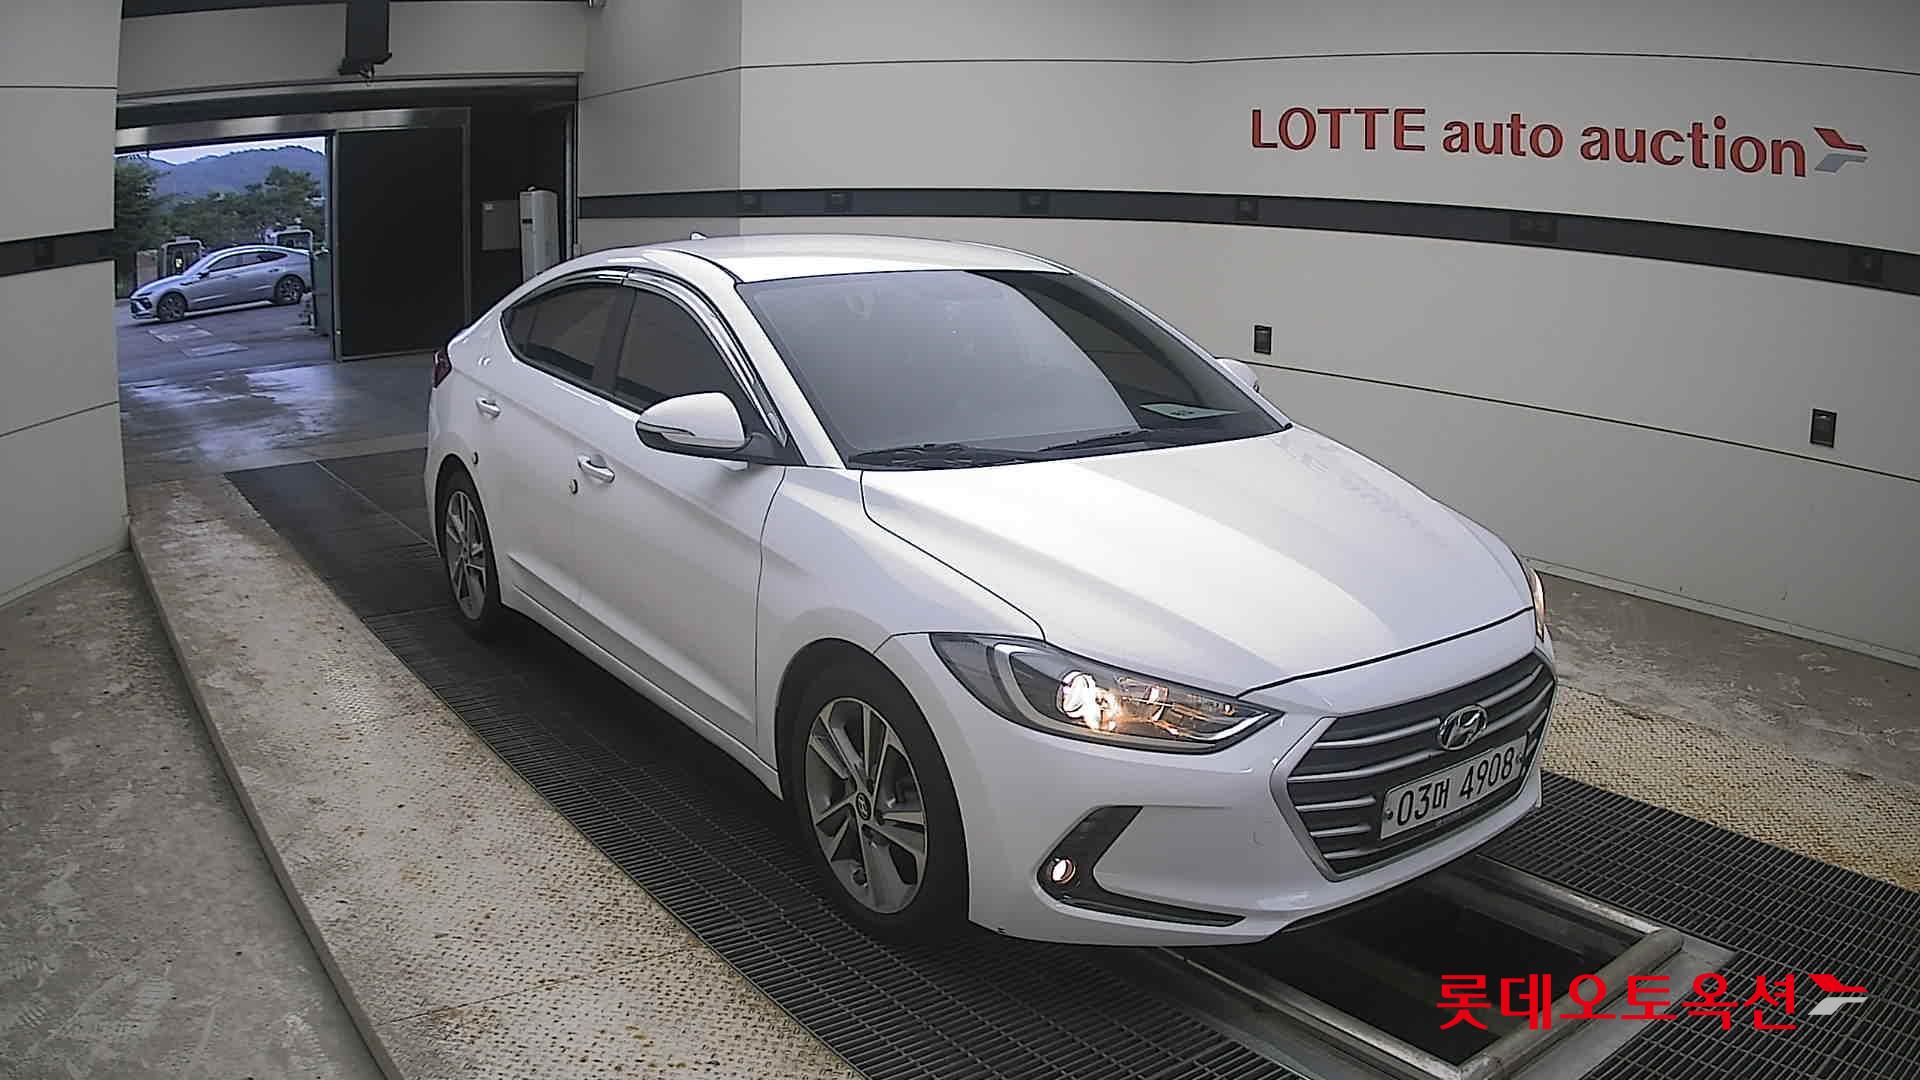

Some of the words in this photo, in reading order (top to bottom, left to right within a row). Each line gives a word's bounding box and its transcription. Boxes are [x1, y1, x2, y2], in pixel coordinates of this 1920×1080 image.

[1251, 107, 1426, 151] LOTTE
[1442, 113, 1566, 158] auto
[1581, 116, 1807, 177] auction
[1397, 778, 1450, 826] 03머
[1459, 746, 1515, 799] 4908
